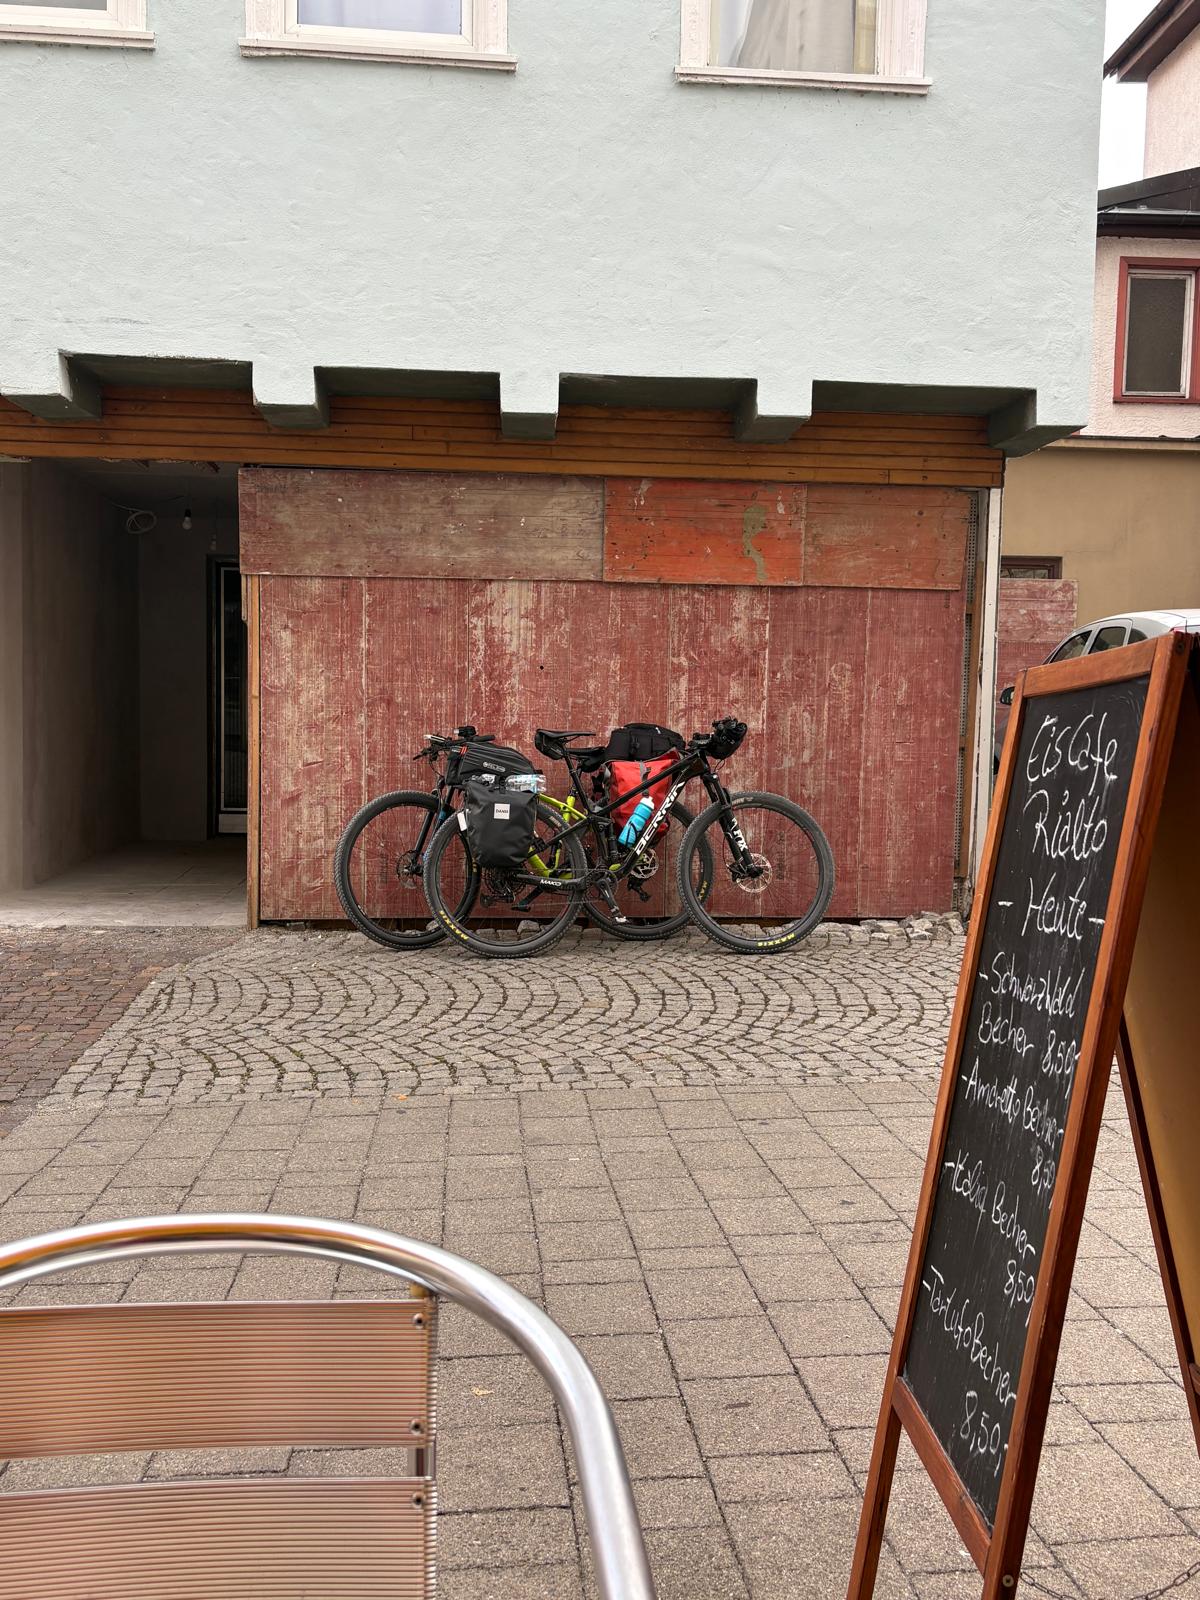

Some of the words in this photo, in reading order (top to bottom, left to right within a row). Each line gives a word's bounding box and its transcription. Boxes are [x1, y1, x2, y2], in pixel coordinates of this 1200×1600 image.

[635, 781, 685, 855] BERRIA
[1023, 790, 1107, 860] Rialto
[438, 910, 470, 941] MAXXIS
[757, 933, 796, 947] MAXXIS
[978, 1001, 1035, 1057] Becher
[1022, 1085, 1065, 1149] Becher
[991, 1180, 1036, 1259] Becher
